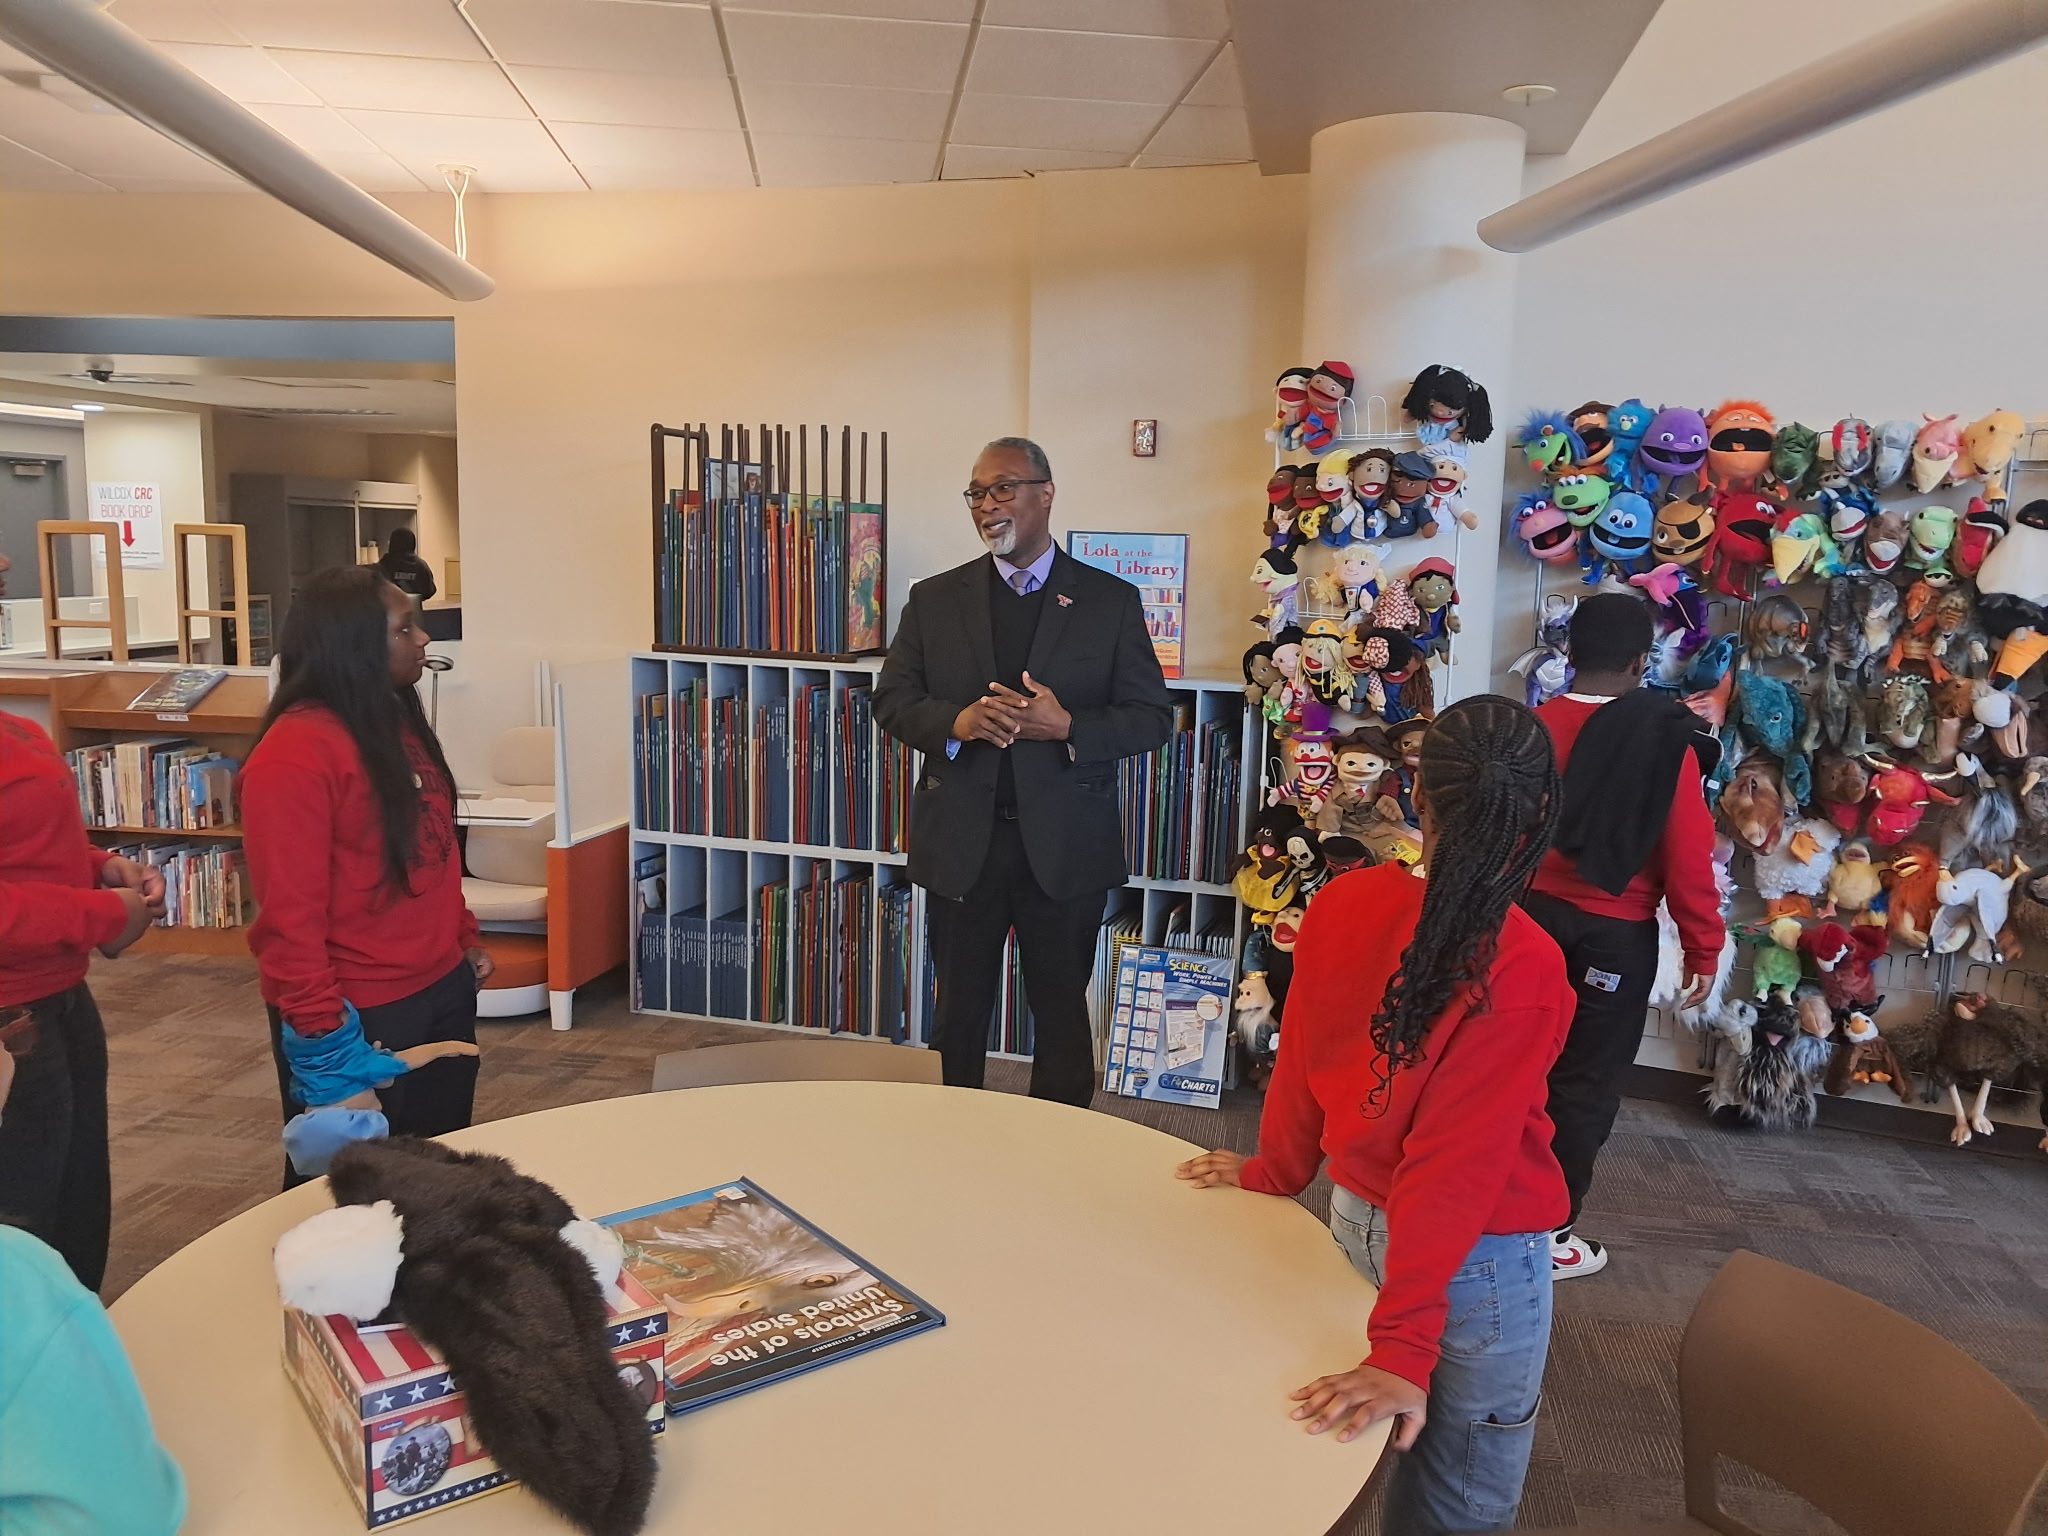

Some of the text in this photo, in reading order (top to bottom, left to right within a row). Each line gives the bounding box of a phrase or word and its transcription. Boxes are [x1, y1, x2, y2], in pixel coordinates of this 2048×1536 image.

[98, 486, 153, 500] WILCOX CRC
[100, 504, 153, 518] BOOK DROP
[1082, 542, 1119, 557] Lola
[1137, 549, 1153, 557] the
[1115, 560, 1179, 580] Library
[1168, 958, 1208, 974] SCIENCE
[711, 1287, 887, 1344] United States
[709, 1299, 904, 1366] Symbols of the
